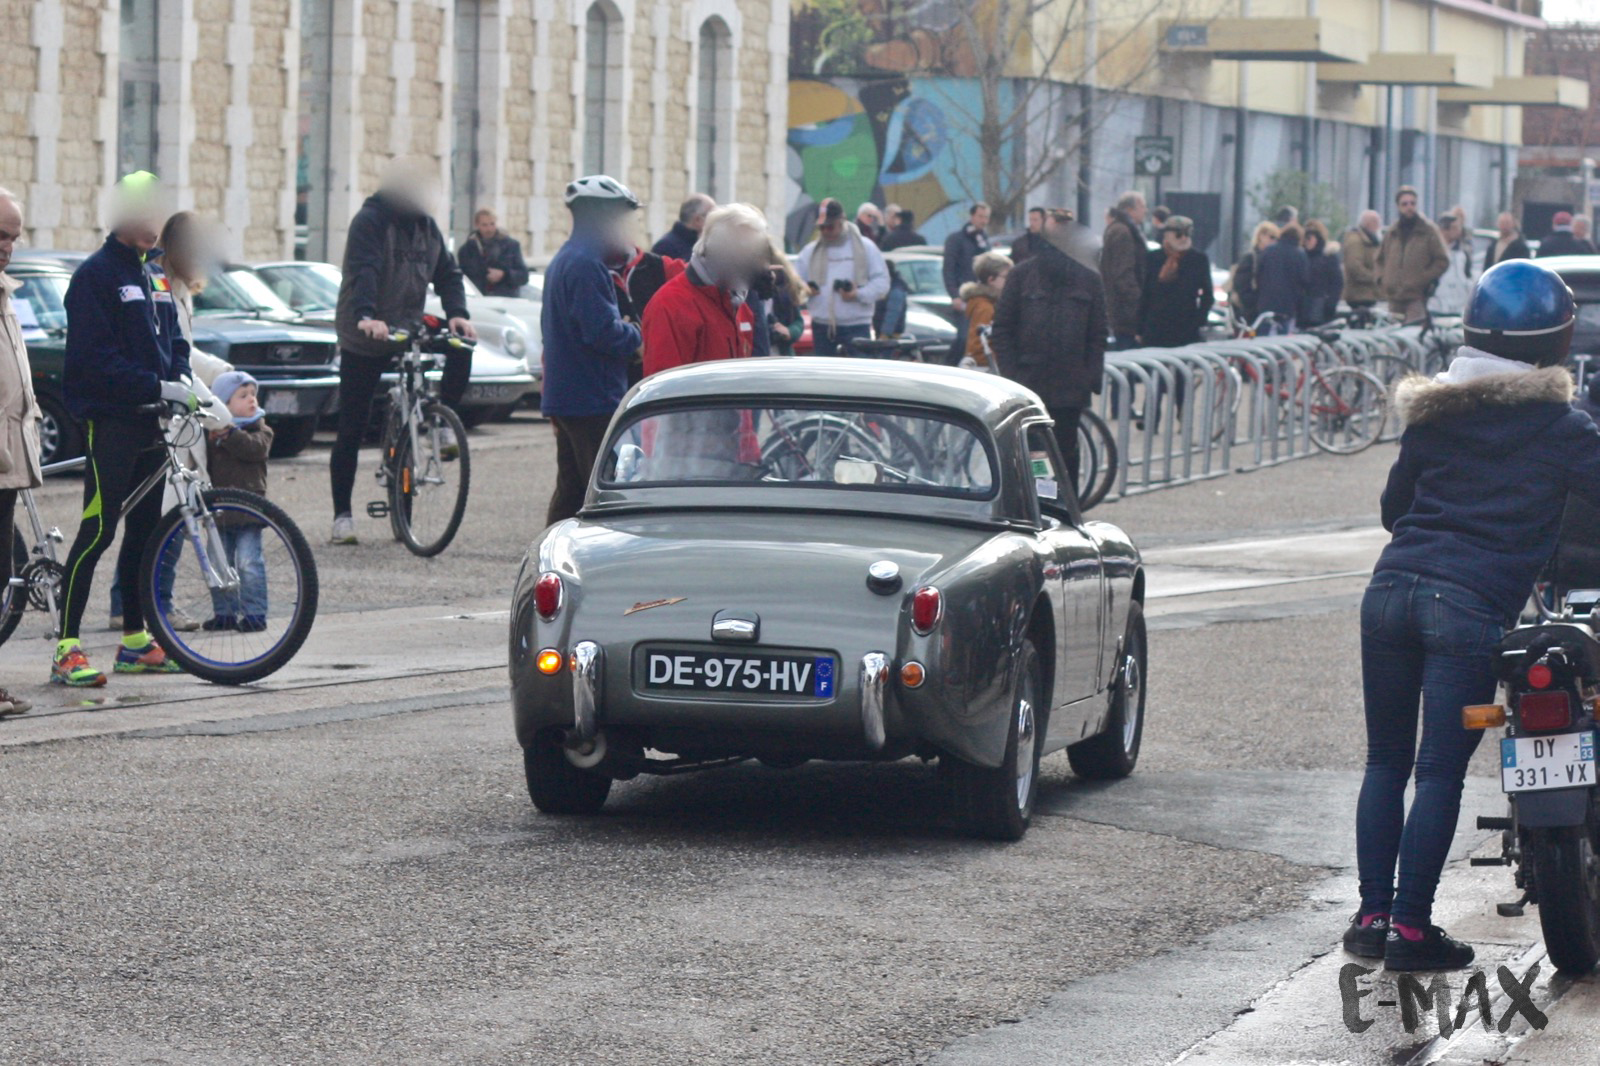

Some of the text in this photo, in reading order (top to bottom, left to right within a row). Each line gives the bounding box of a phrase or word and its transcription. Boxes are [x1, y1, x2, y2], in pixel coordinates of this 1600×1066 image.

[649, 655, 812, 692] DE-975-HV
[820, 682, 828, 691] F
[1534, 738, 1555, 758] DY
[1581, 748, 1594, 760] 33
